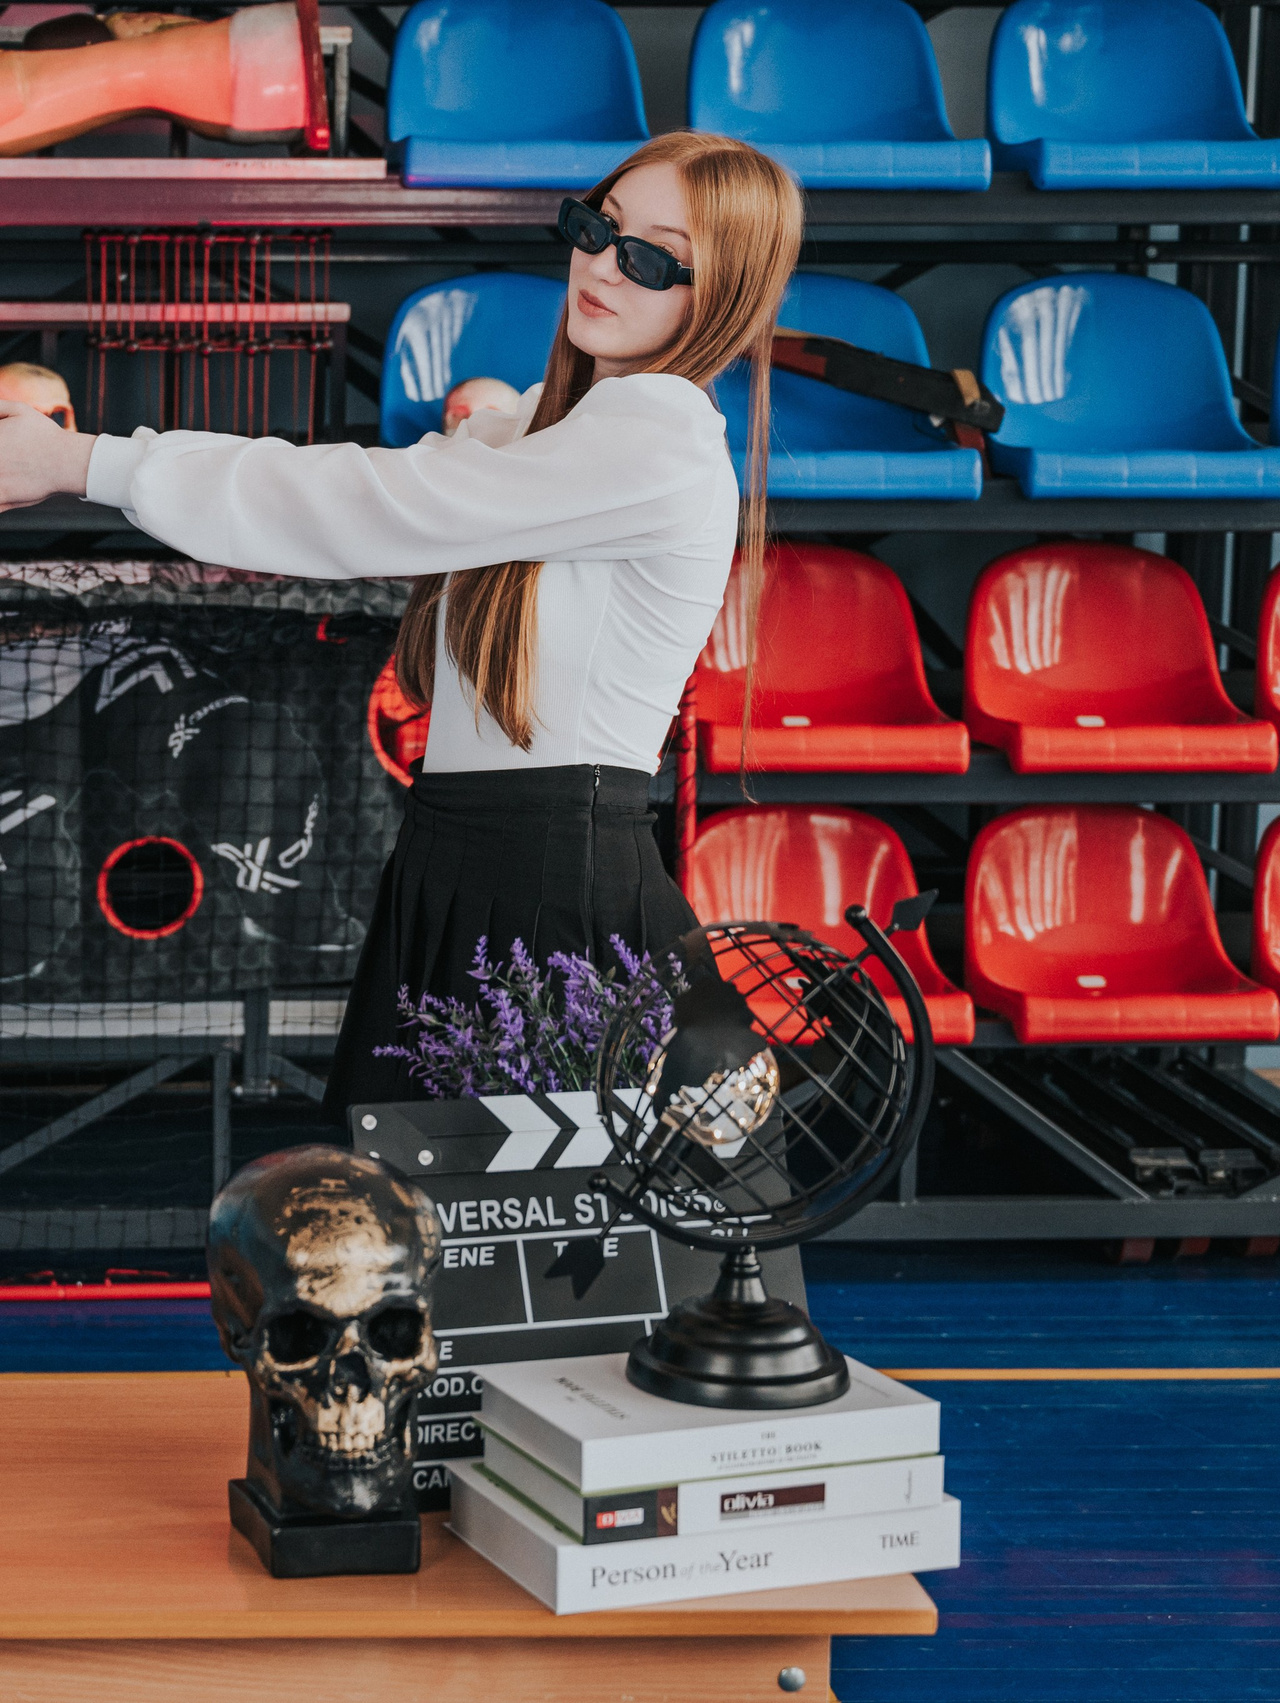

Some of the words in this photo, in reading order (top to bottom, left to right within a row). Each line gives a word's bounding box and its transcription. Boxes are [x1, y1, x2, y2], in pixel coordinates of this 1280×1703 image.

[436, 1195, 566, 1234] VERSAL
[442, 1245, 496, 1269] ENE
[553, 1237, 619, 1259] TE
[417, 1422, 485, 1444] IREC
[711, 1446, 777, 1463] STILETTO
[785, 1440, 822, 1454] BOOK
[723, 1492, 775, 1513] olivia
[879, 1531, 920, 1550] TIME
[591, 1562, 677, 1588] Person
[719, 1549, 773, 1573] Year
